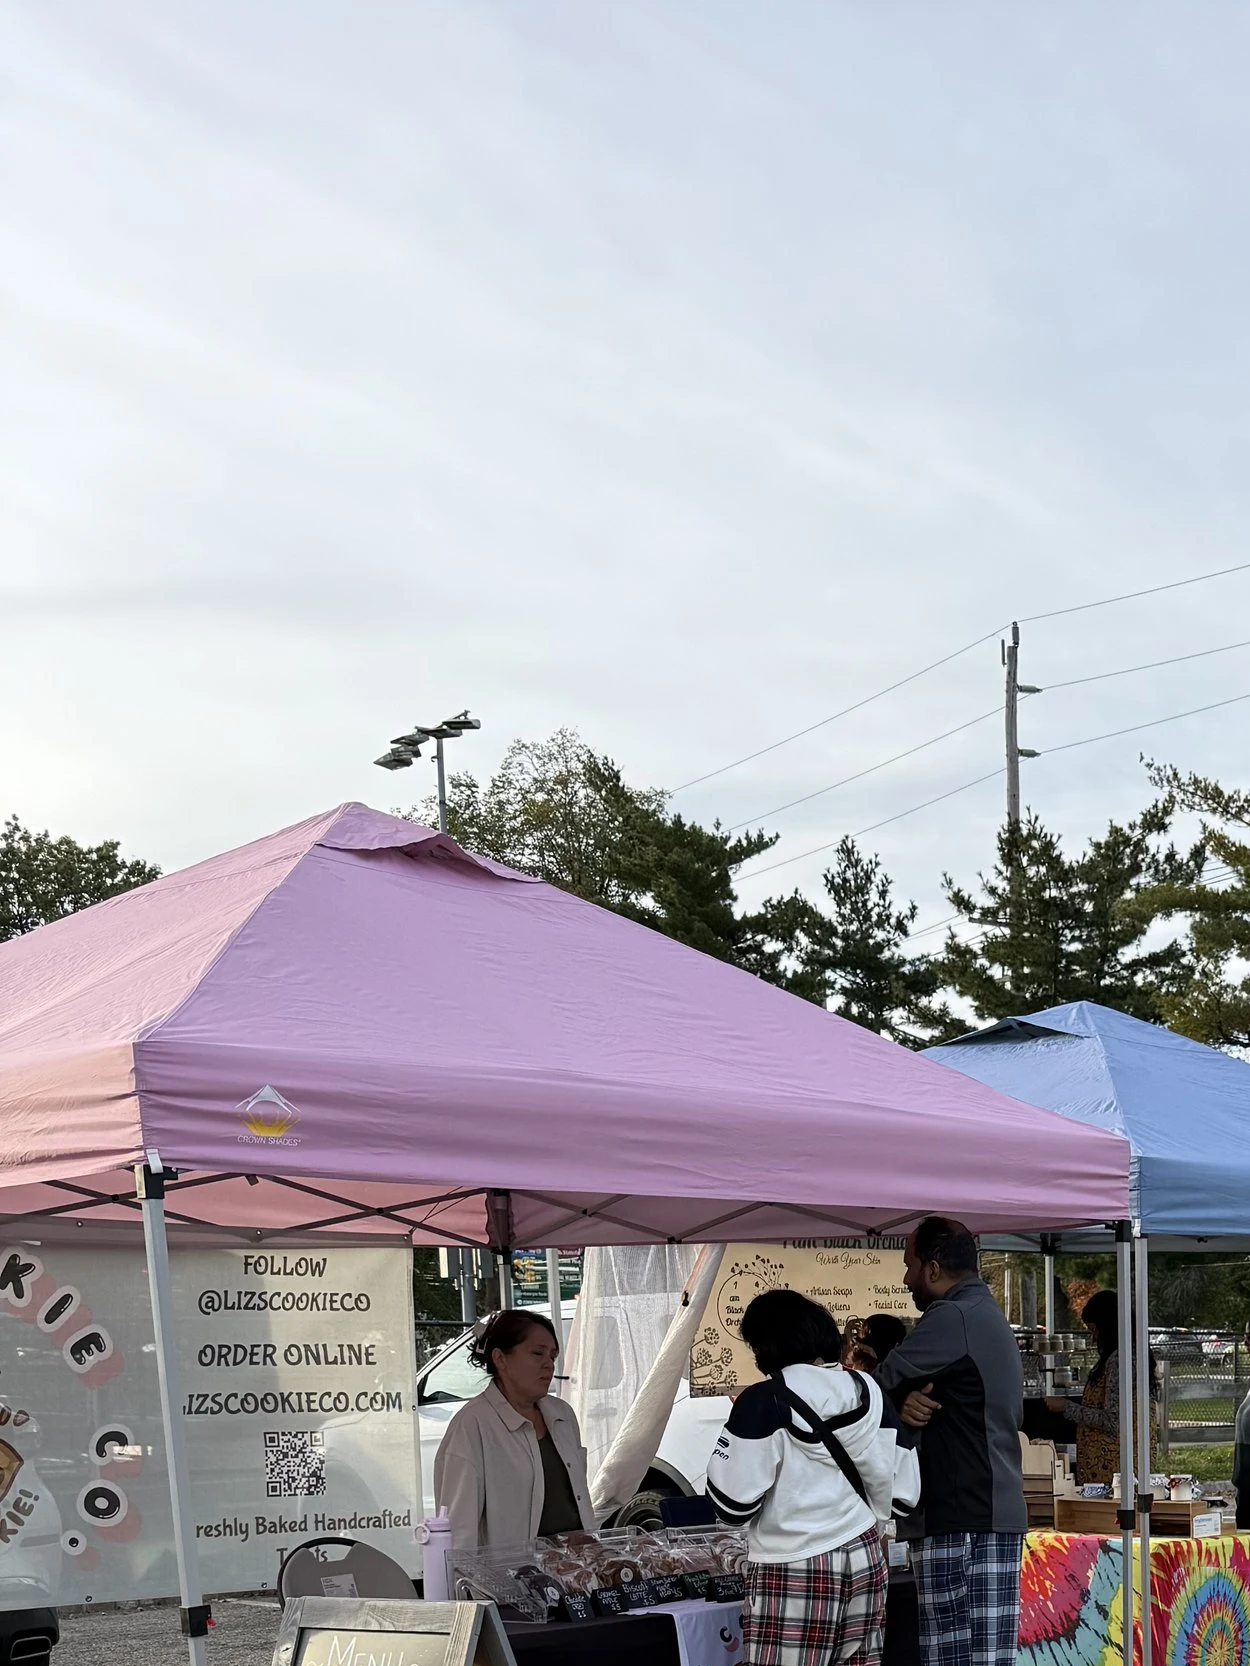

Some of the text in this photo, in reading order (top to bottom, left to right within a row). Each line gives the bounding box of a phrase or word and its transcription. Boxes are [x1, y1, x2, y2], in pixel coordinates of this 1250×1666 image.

[238, 1135, 298, 1147] CROWN SHADES
[243, 1255, 328, 1278] FOLLOW
[833, 1286, 853, 1298] Soaps
[873, 1284, 890, 1297] Body
[198, 1289, 372, 1316] @LIZSCOOKIECO
[873, 1299, 907, 1310] Facial Care
[198, 1343, 377, 1367] ORDER ONLINE
[183, 1391, 403, 1416] IZSCOOKIECO.COM
[712, 1448, 730, 1461] pen
[195, 1508, 412, 1543] reshly Baked Handcrafted
